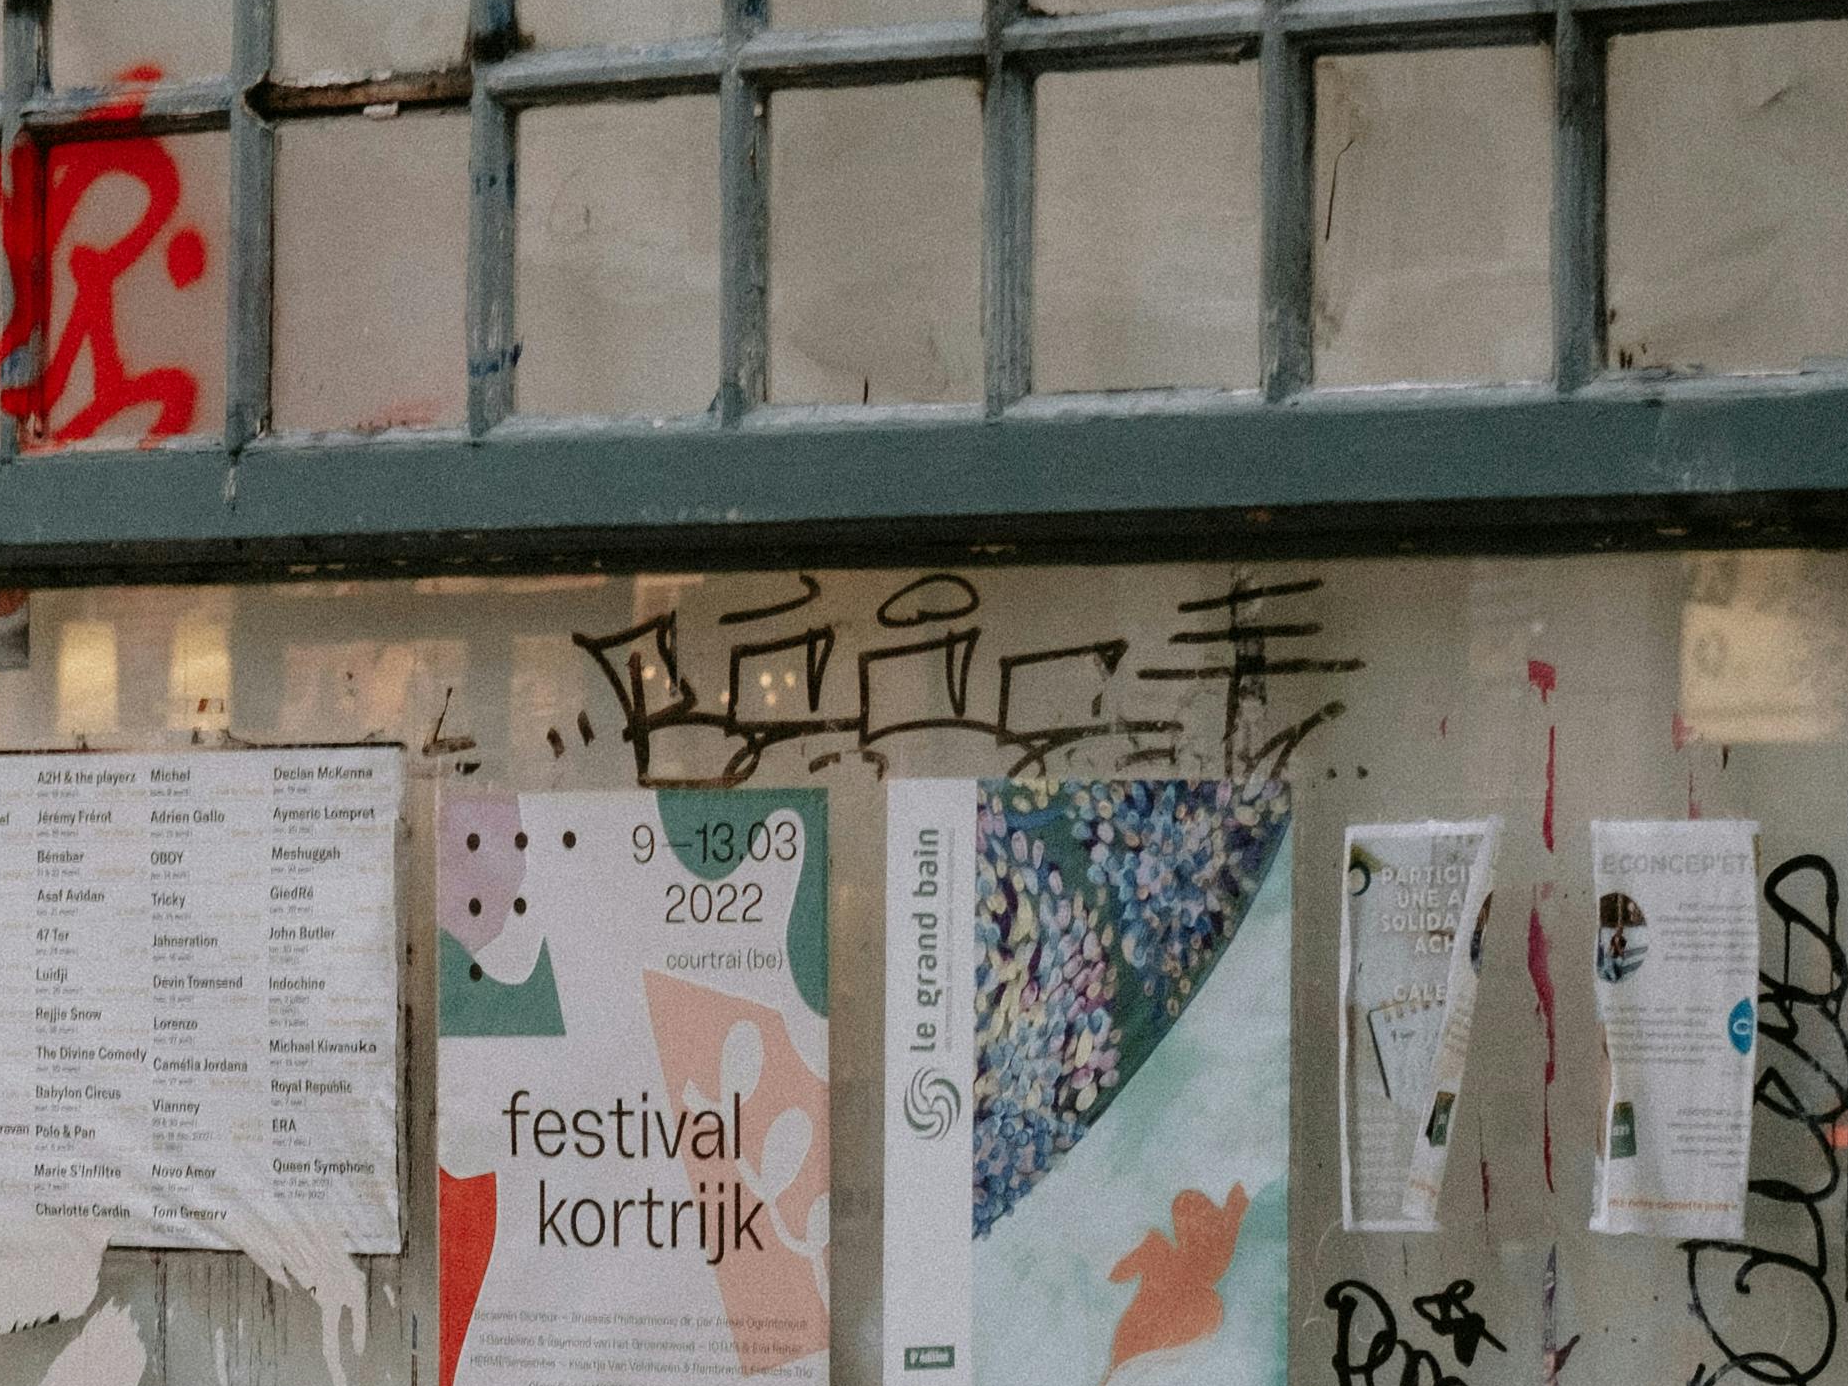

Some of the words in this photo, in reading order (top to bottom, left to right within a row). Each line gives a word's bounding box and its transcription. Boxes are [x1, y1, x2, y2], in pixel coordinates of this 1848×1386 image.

[151, 810, 190, 823] Adrien
[194, 810, 225, 823] Gallo
[912, 829, 939, 897] bain
[151, 893, 185, 909] Tricky
[665, 883, 763, 924] 2022
[666, 949, 741, 970] courtrai
[746, 949, 783, 972] (be)
[912, 913, 942, 1007] grand
[188, 975, 243, 989] Townsend
[70, 1007, 102, 1021] Snow
[910, 1022, 937, 1052] le
[37, 1046, 56, 1060] The
[60, 1047, 95, 1061] Divine
[269, 1040, 313, 1053] Michael
[85, 1086, 121, 1100] Circus
[272, 1119, 296, 1133] ERA
[503, 1090, 741, 1159] festival
[75, 1126, 95, 1139] Pan
[34, 1164, 66, 1177] Marie
[538, 1180, 765, 1265] kortrijk
